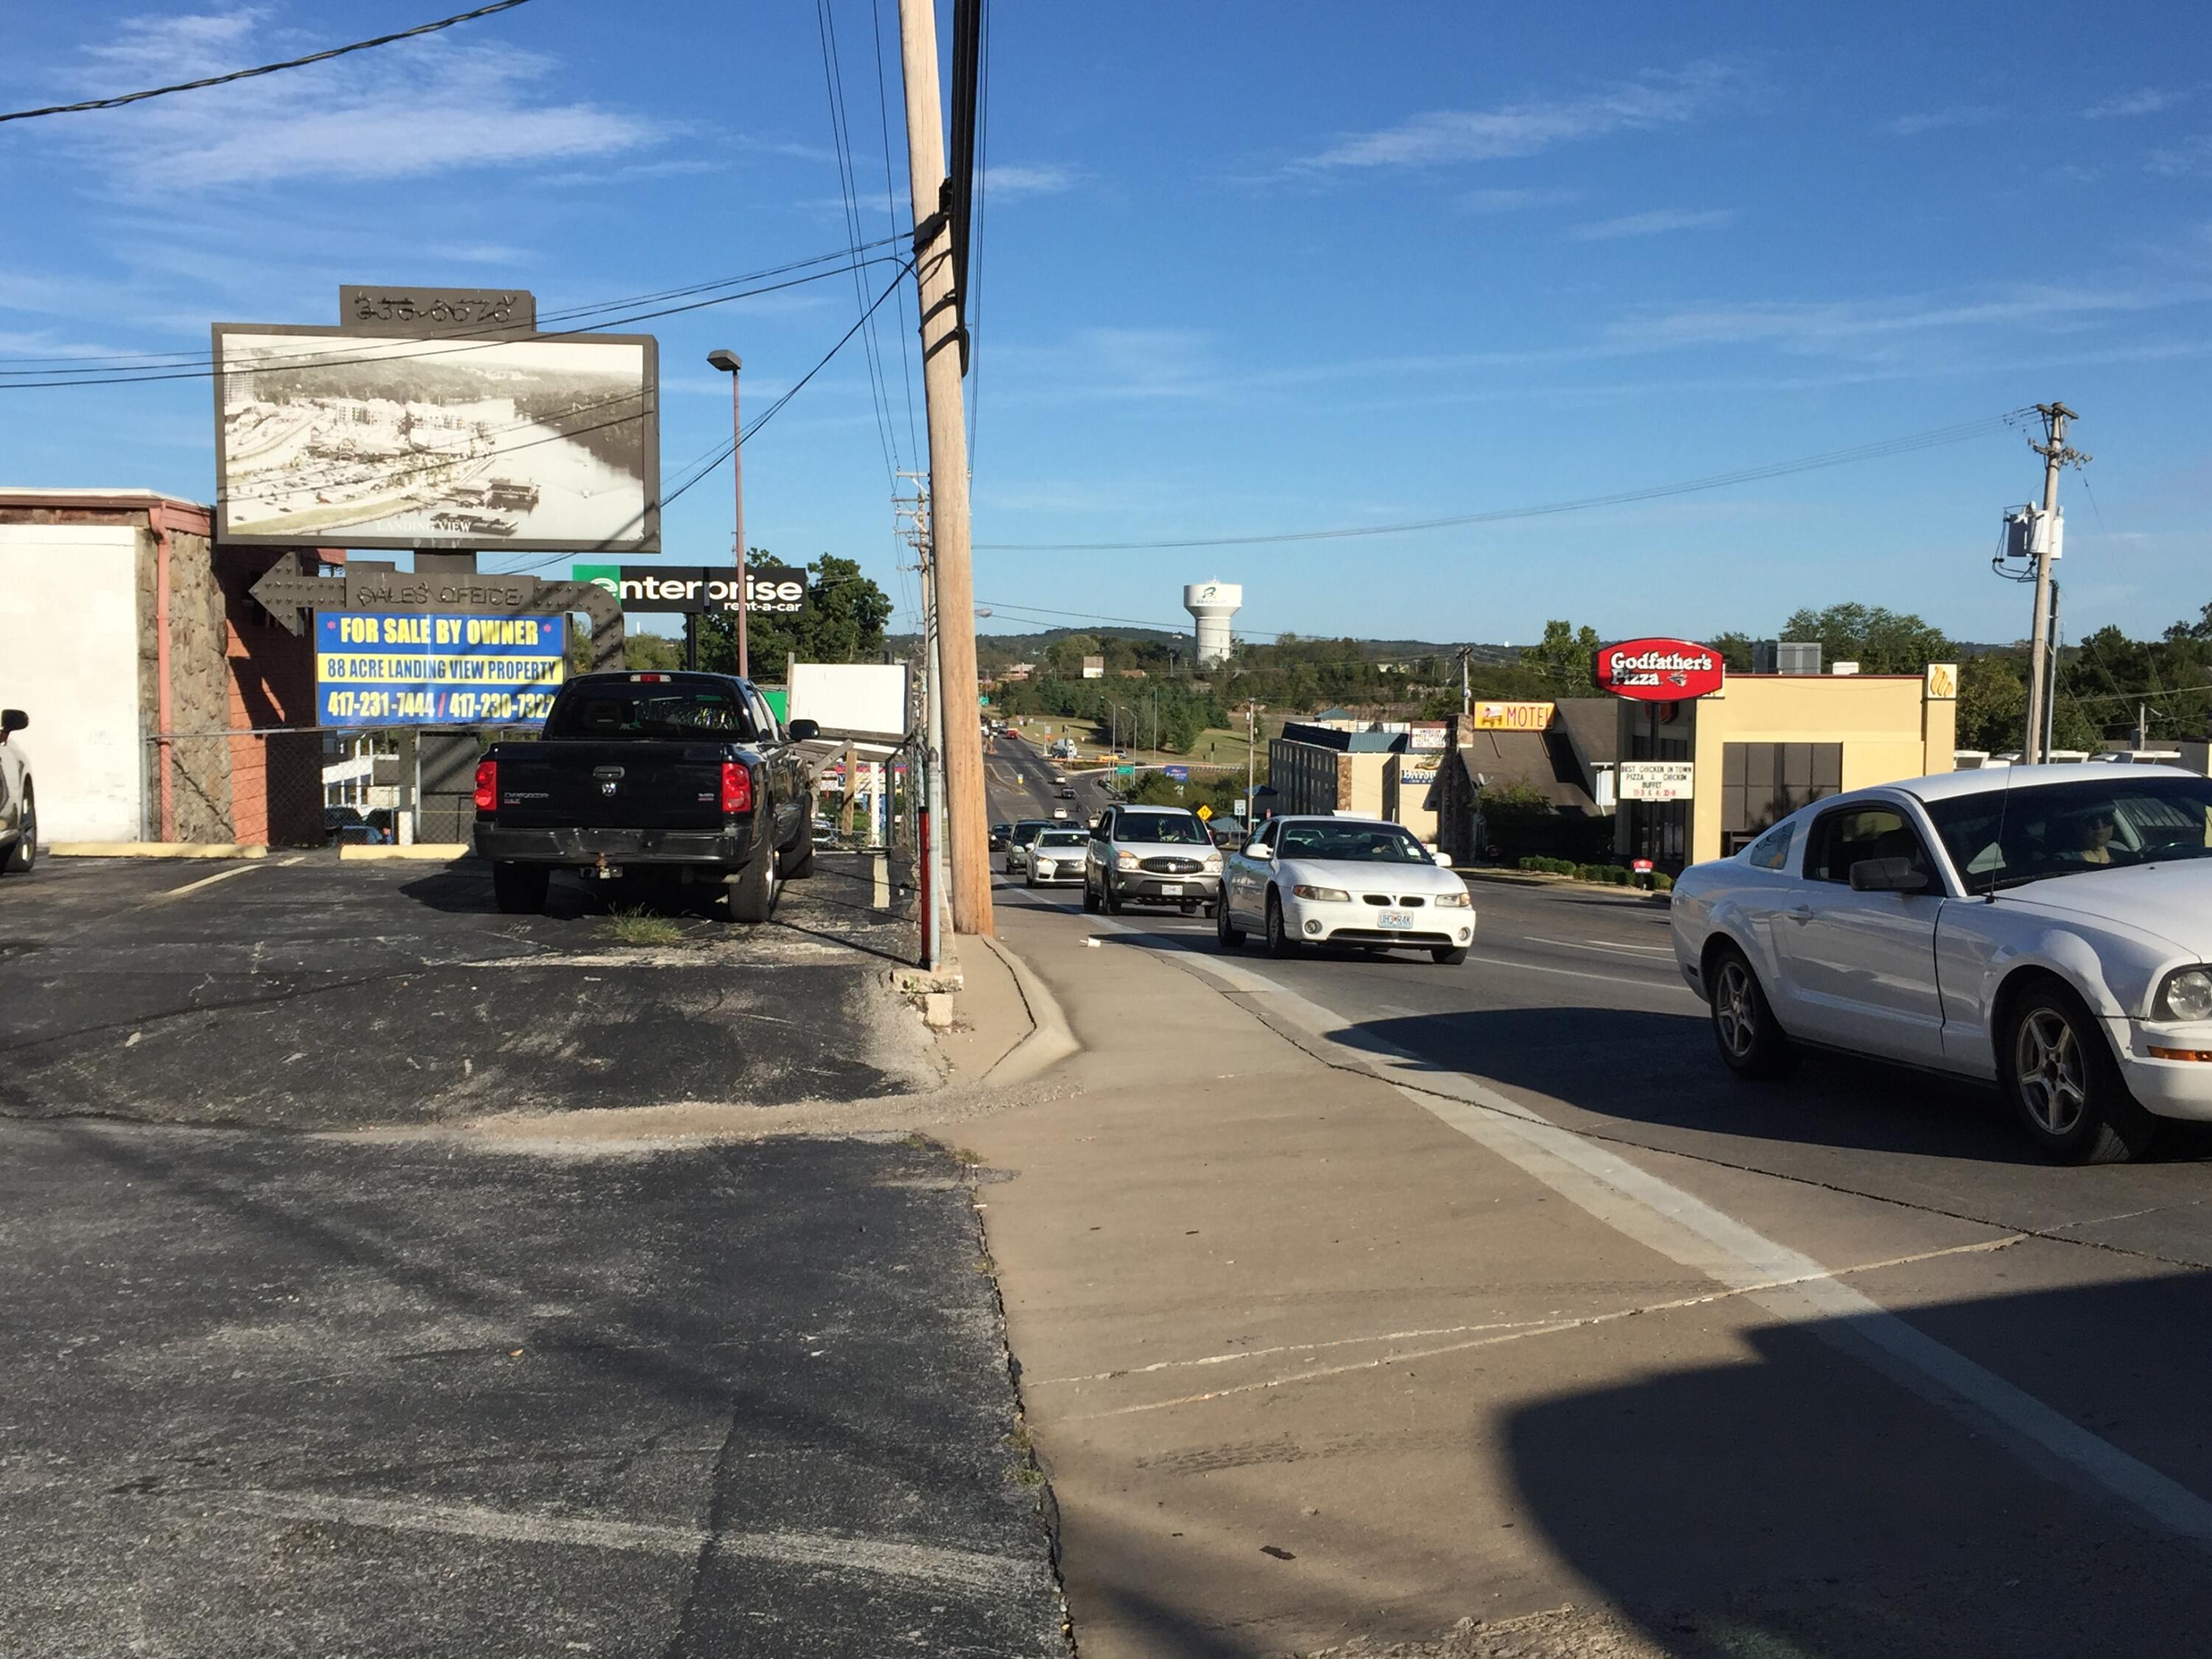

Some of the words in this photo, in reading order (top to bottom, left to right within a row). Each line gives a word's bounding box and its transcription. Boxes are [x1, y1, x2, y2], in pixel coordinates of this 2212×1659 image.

[377, 520, 434, 532] LANDING
[438, 521, 471, 532] VIEW
[357, 583, 429, 606] SALES
[437, 586, 524, 605] OFFICE
[590, 574, 803, 606] enterprise
[723, 601, 803, 611] rent-a-car
[341, 617, 380, 643] FOR
[383, 619, 431, 644] SALE
[436, 620, 462, 644] BY
[467, 620, 539, 645] OWNER
[327, 658, 346, 678] 88
[349, 658, 384, 678] ACRE
[388, 659, 446, 678] LANDING
[450, 661, 484, 679] VIEW
[488, 661, 556, 681] PROPERTY
[1610, 652, 1712, 670] Godfather's
[1610, 668, 1659, 686] Pizza
[327, 691, 435, 717] 417-231-7444
